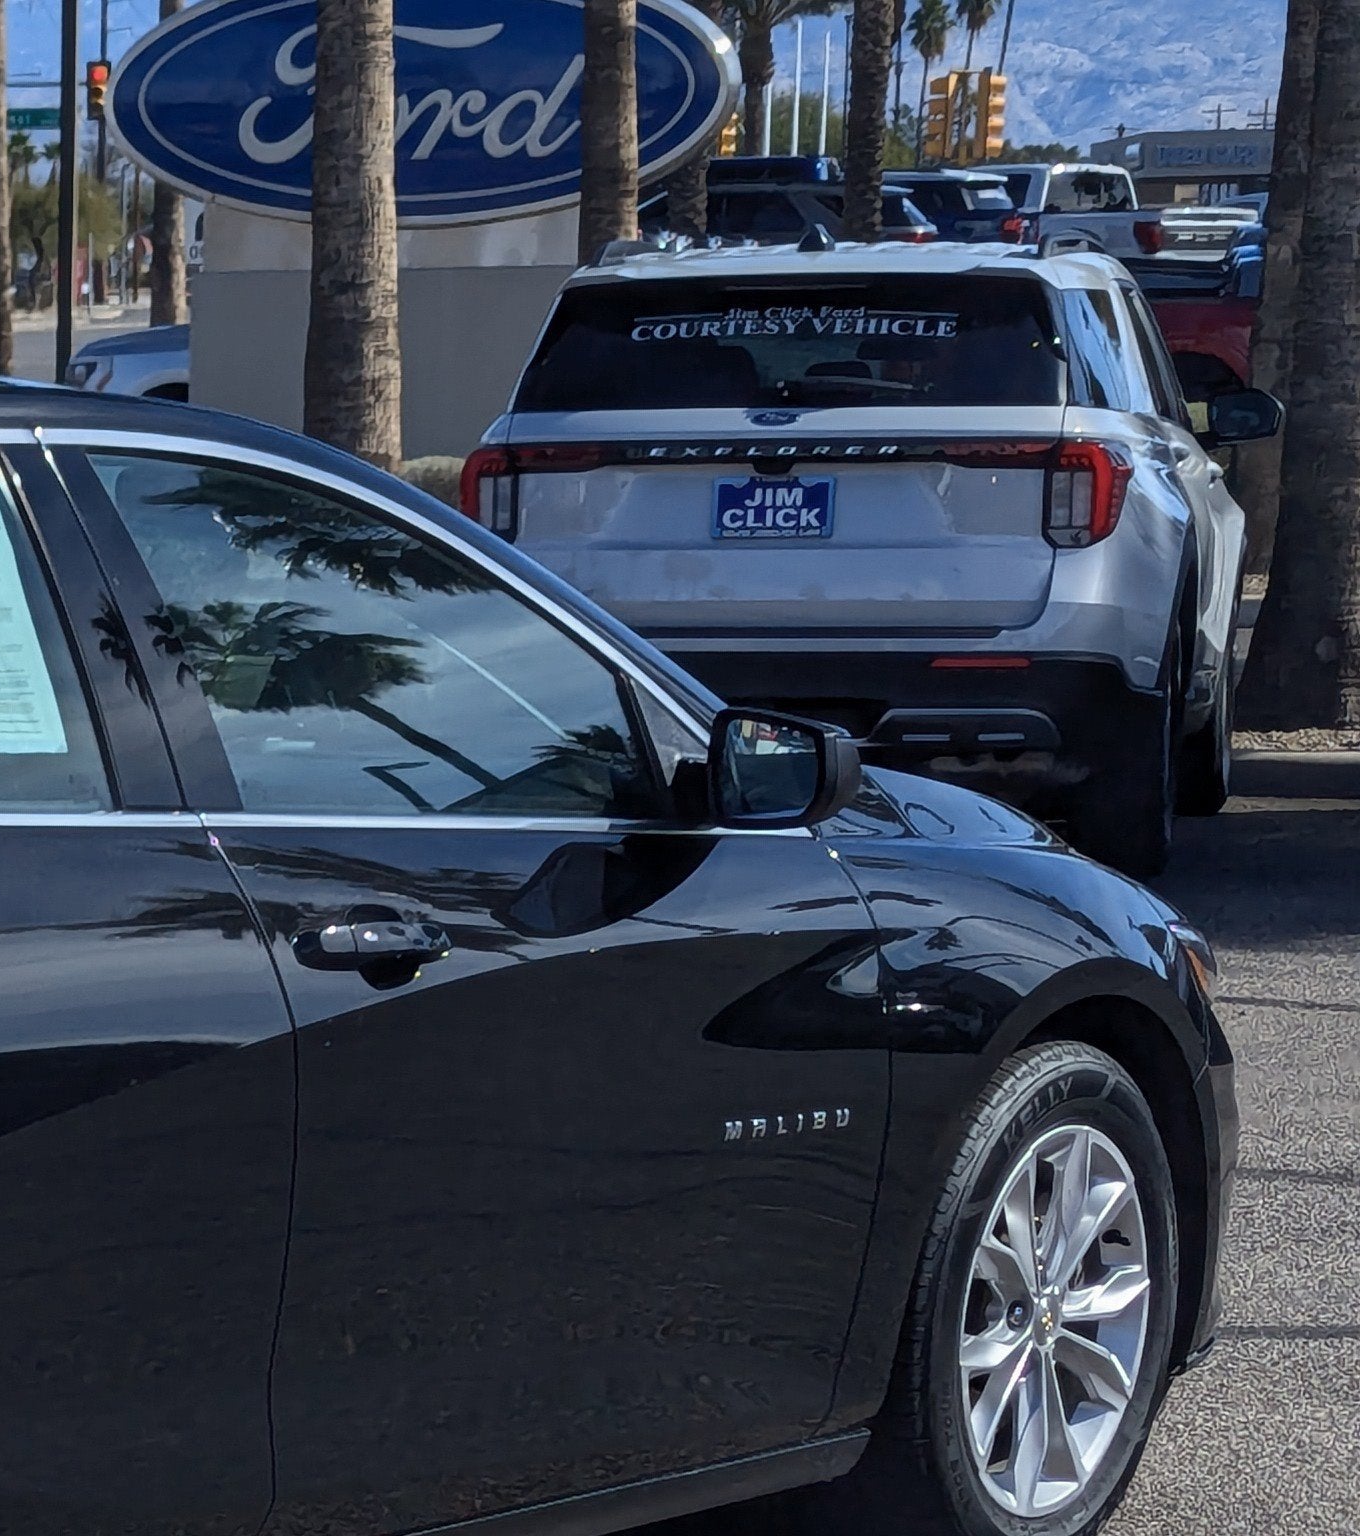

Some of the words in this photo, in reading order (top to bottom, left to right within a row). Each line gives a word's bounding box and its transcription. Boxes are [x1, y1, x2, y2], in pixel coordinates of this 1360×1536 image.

[238, 23, 585, 164] Frd
[631, 318, 804, 341] COURTESY
[811, 318, 958, 338] VEHICLE
[649, 446, 898, 456] EXPLORER
[744, 487, 804, 507] JIM
[722, 508, 821, 528] CLICK
[723, 1108, 851, 1142] MALIBU
[1002, 1075, 1074, 1154] KELLY
